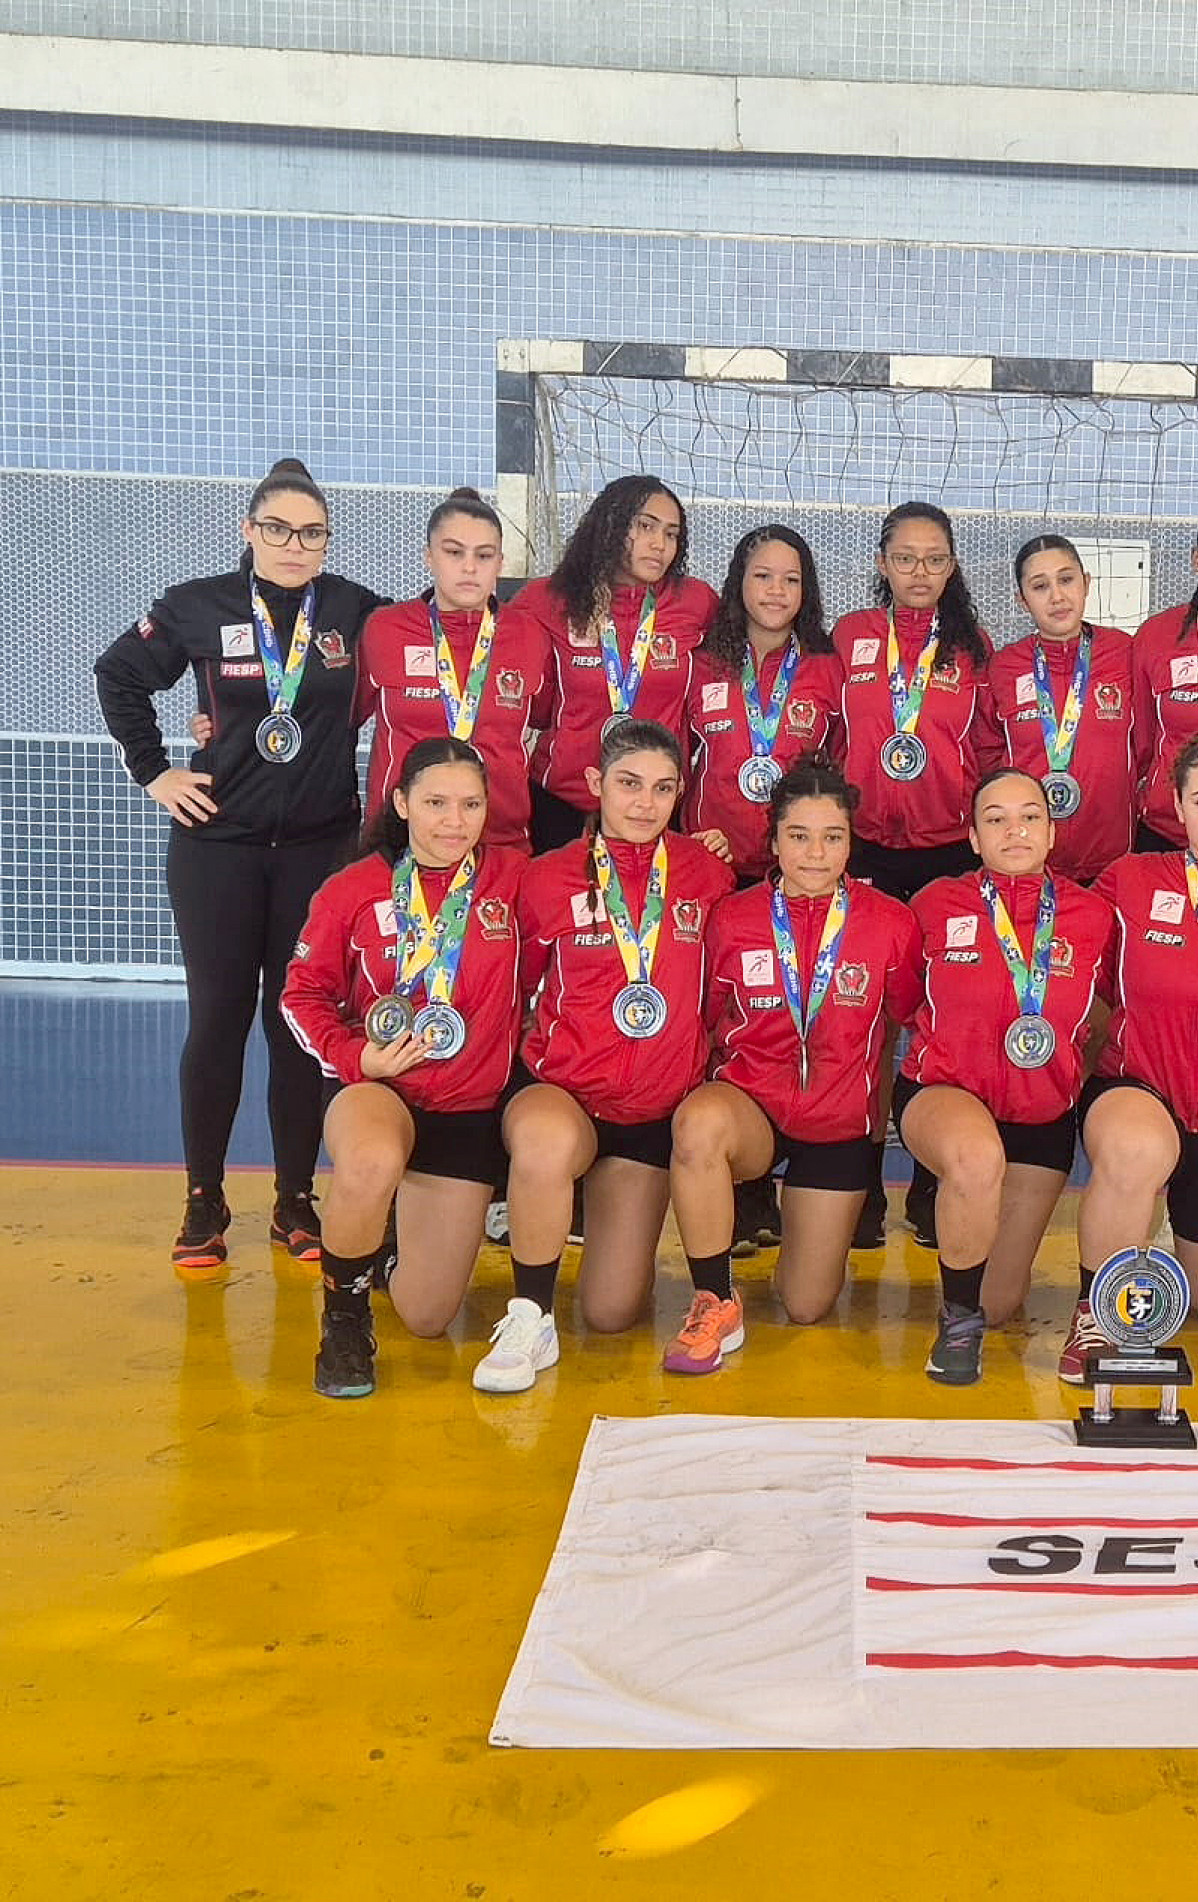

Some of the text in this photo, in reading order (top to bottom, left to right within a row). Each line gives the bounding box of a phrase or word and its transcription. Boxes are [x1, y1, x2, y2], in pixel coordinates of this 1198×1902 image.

[571, 655, 602, 667] FIESP
[222, 664, 260, 676] FIESP
[405, 687, 440, 698] FIESP
[704, 720, 733, 734] FIESP
[574, 933, 612, 946] FIESP
[1145, 929, 1183, 946] FIESP
[944, 951, 979, 963] FIESP
[750, 996, 782, 1008] FIESP
